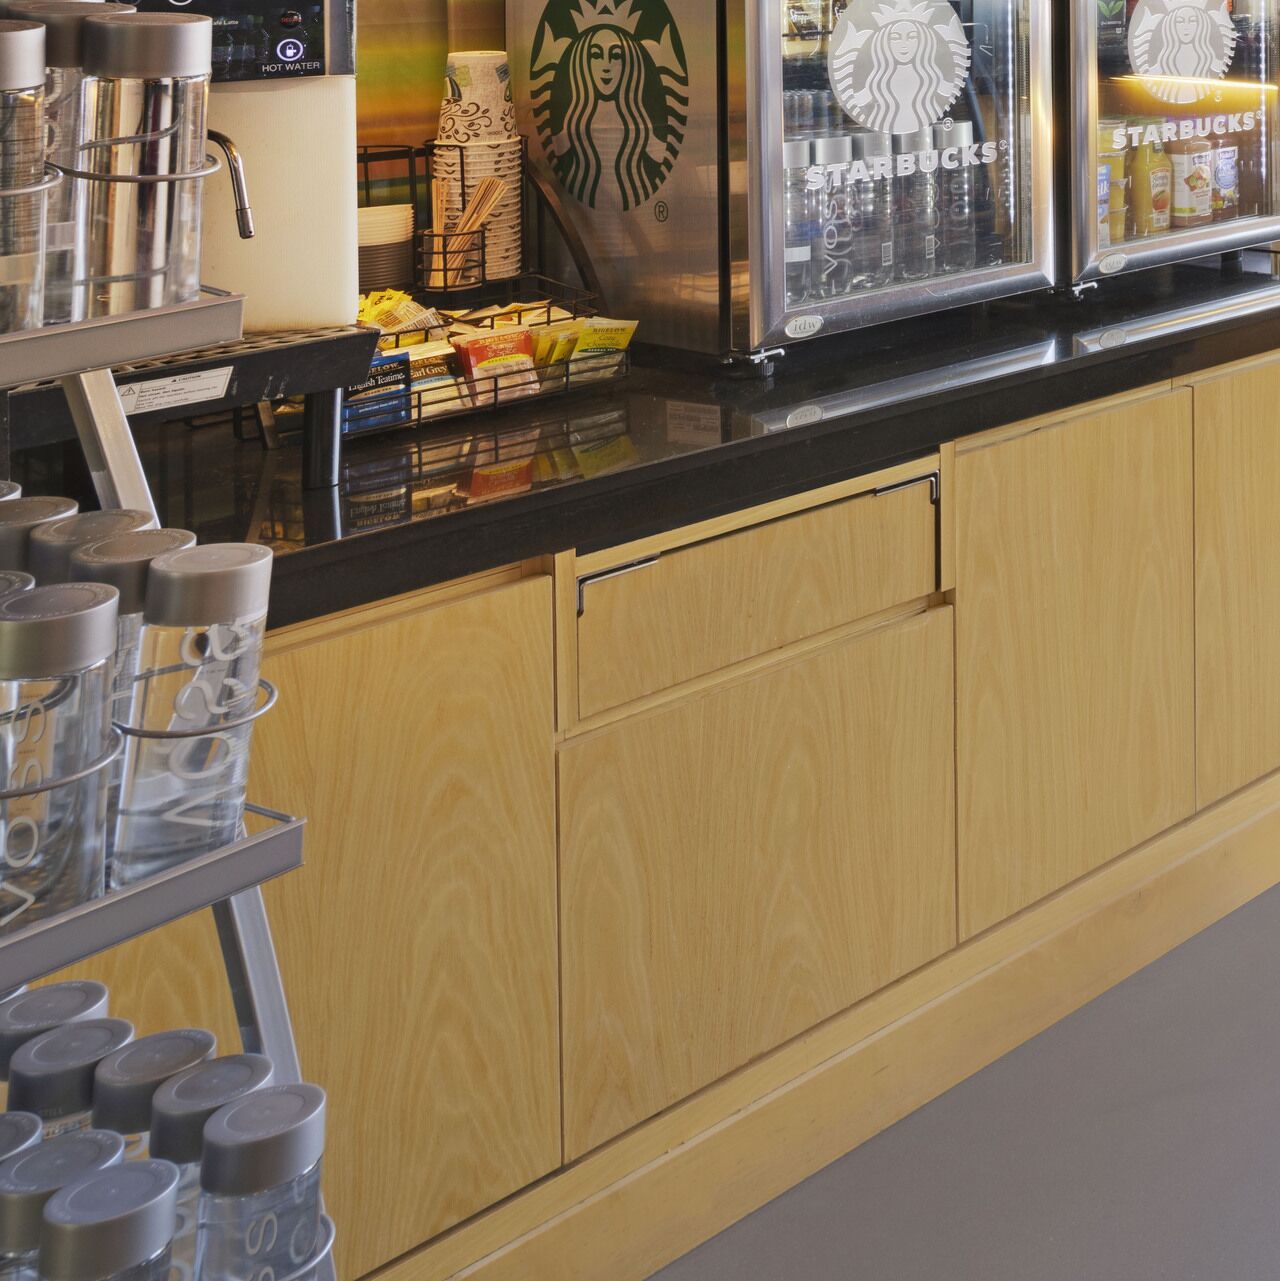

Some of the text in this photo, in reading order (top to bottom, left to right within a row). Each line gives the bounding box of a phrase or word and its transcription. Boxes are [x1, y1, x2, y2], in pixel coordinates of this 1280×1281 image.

[261, 61, 321, 73] HOT WATER
[425, 364, 448, 376] Grey
